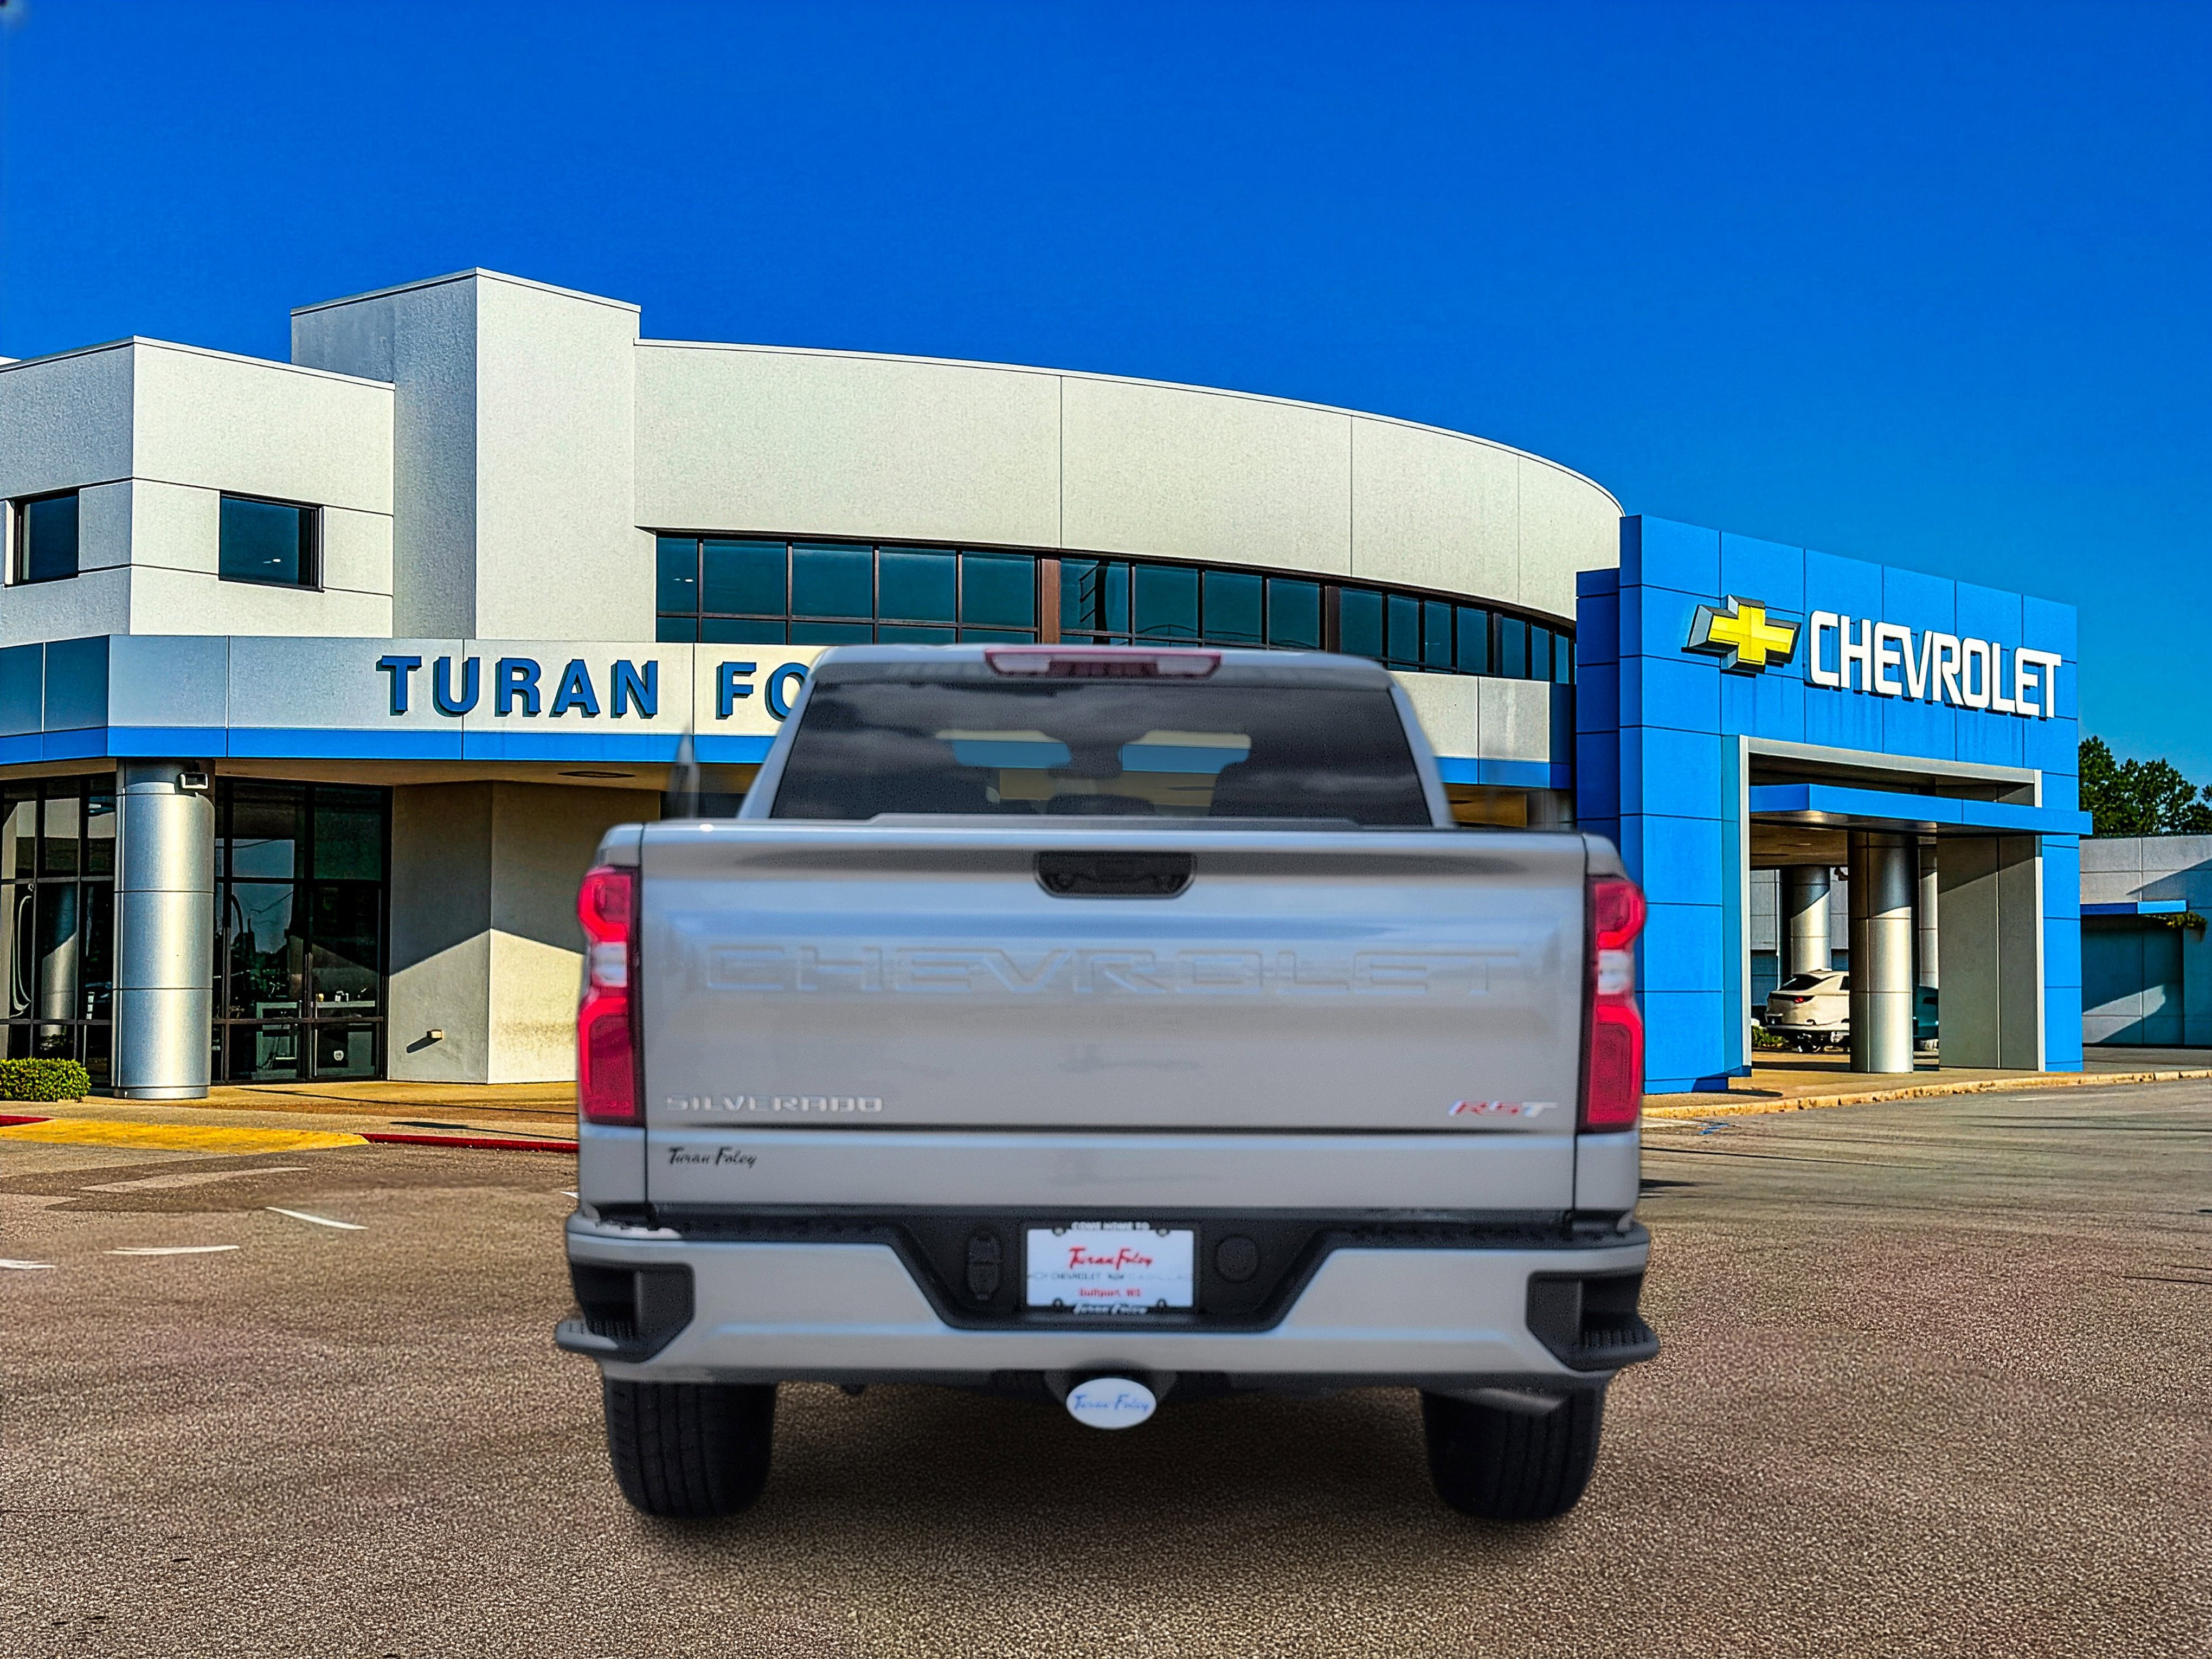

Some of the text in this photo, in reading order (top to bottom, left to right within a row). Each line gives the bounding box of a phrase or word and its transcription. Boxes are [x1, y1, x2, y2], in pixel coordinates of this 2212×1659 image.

[1806, 609, 2062, 720] CHEVROLET
[376, 655, 659, 719] TURAN
[706, 945, 1519, 996] CHEVROLET
[666, 1093, 884, 1113] SILVERADO
[1448, 1100, 1558, 1118] RST
[667, 1146, 757, 1169] Turan Foley
[1115, 1248, 1153, 1270] Foley
